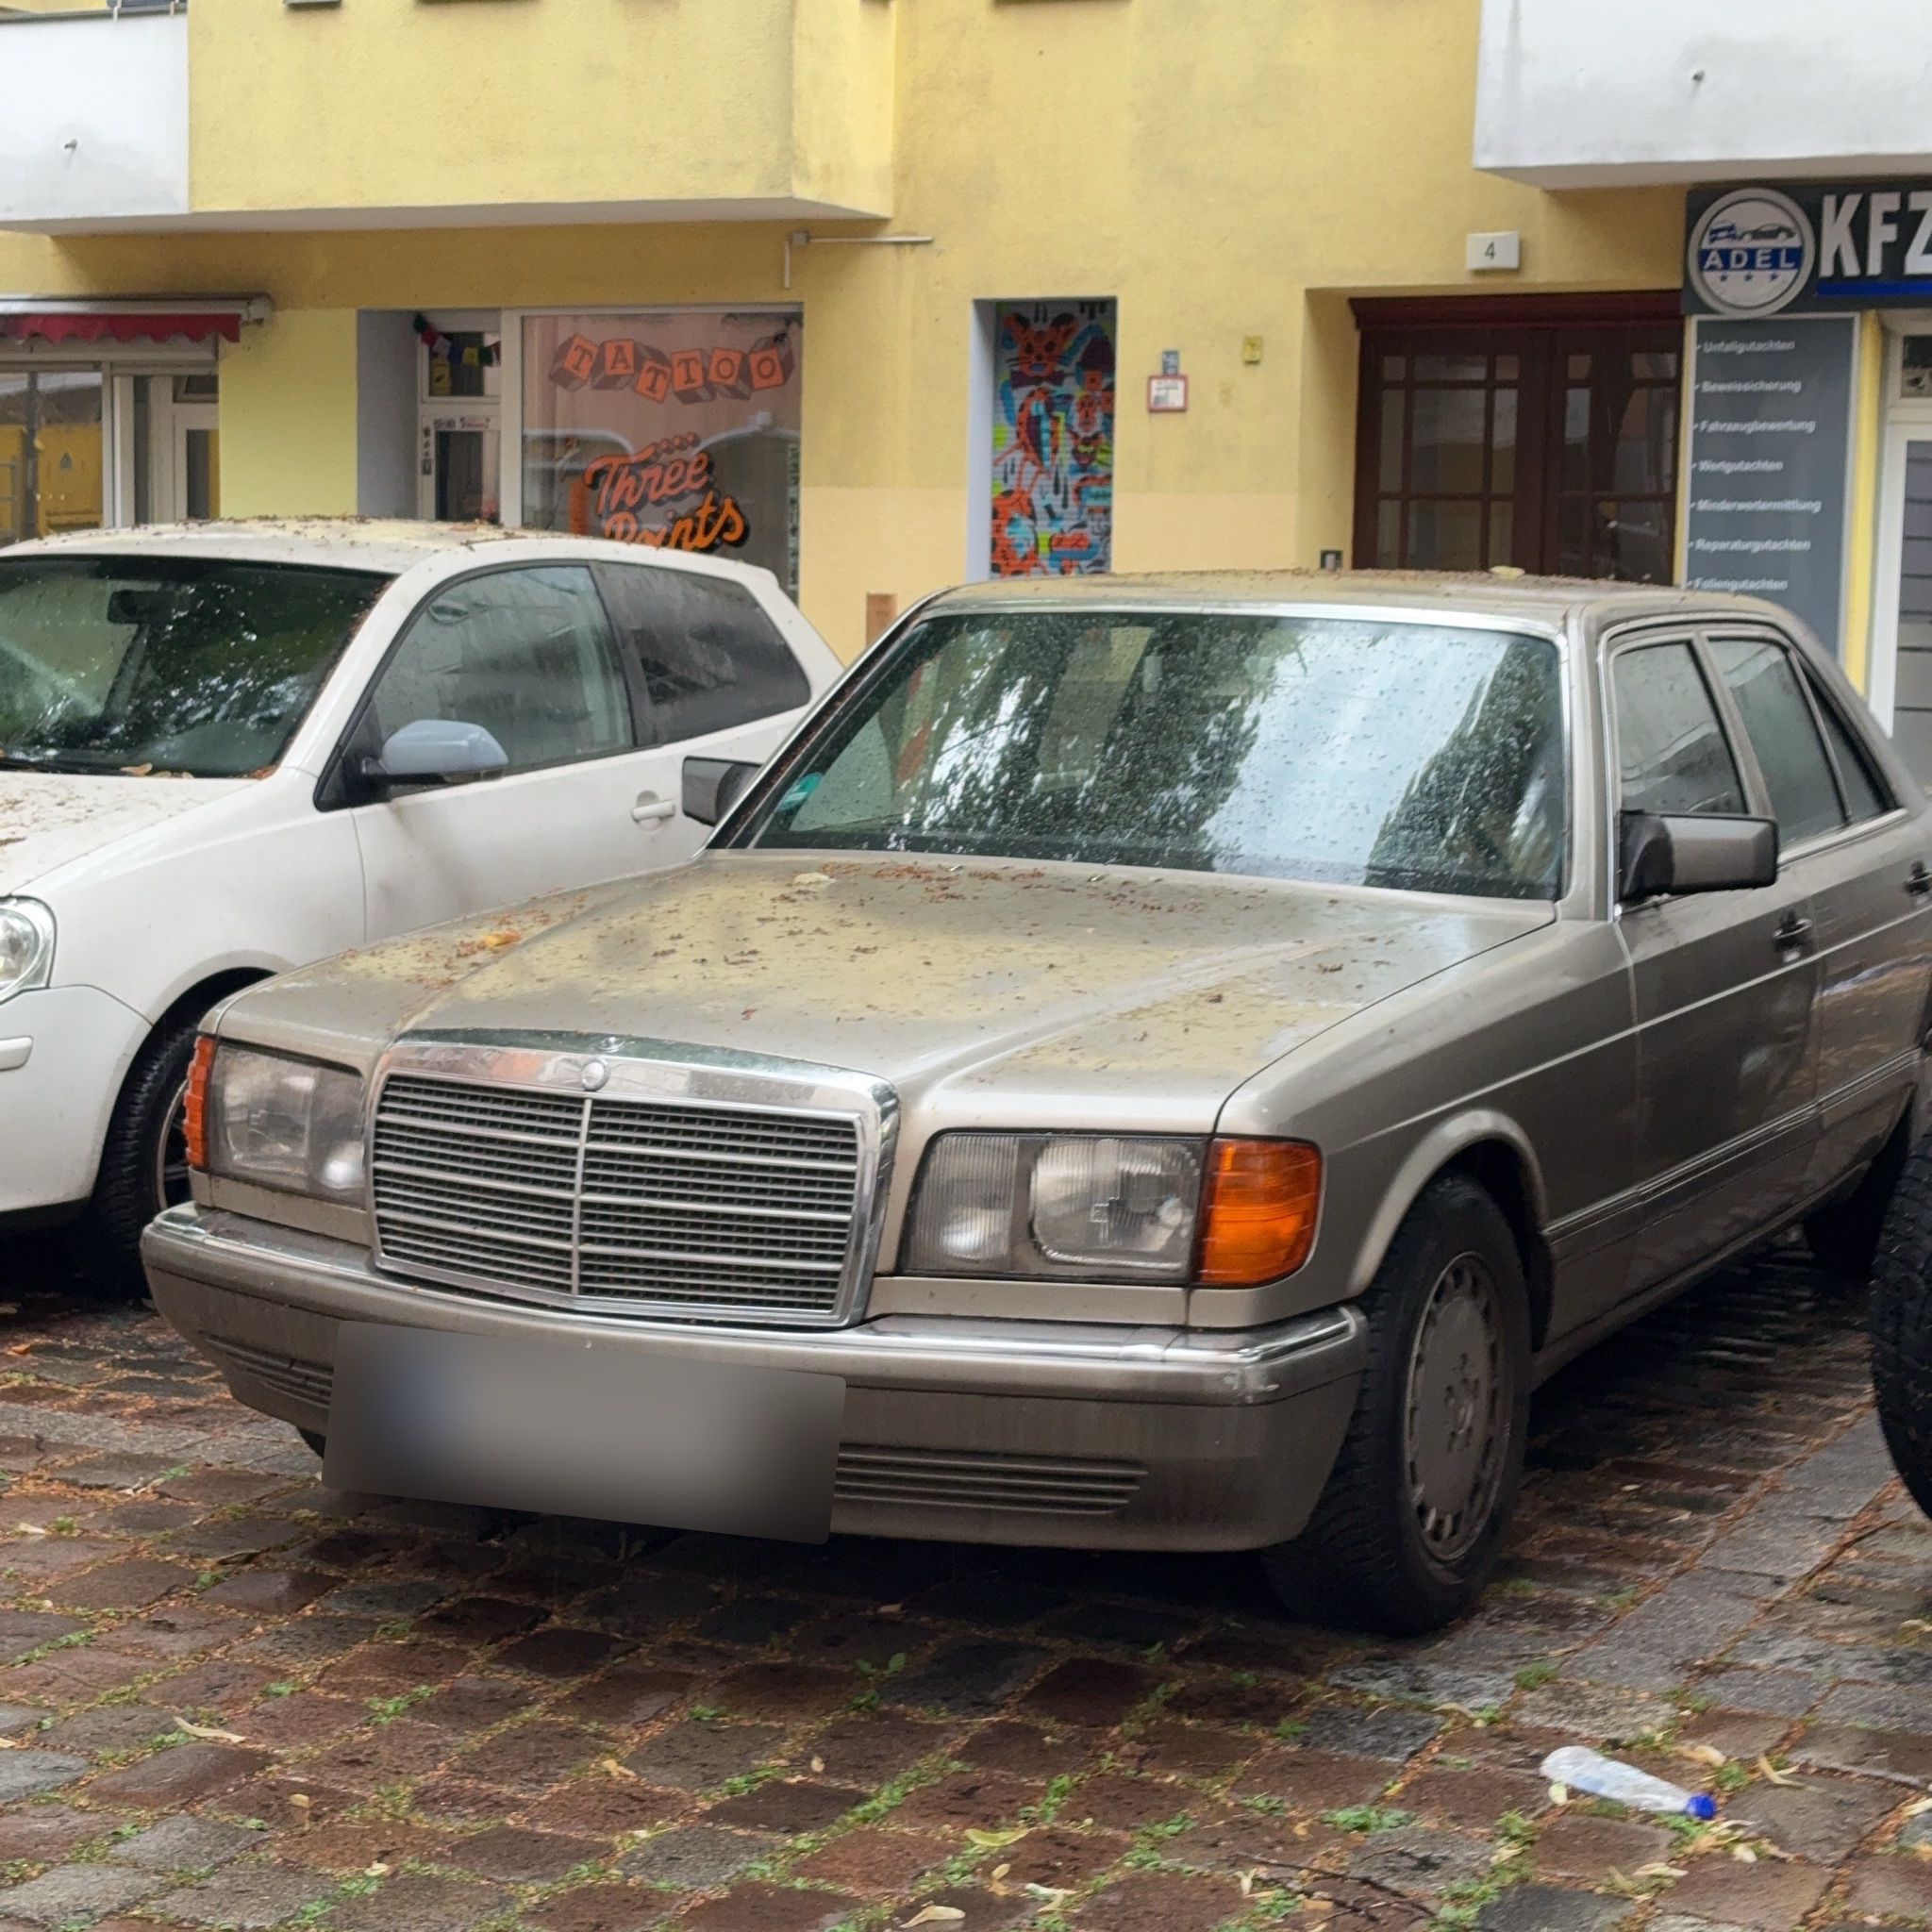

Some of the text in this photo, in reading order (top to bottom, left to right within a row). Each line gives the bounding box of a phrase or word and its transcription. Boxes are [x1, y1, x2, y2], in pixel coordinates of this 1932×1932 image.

[1818, 192, 1932, 277] KFZ
[1484, 241, 1496, 260] 4
[1703, 248, 1796, 270] ADEL
[571, 343, 777, 395] TATTOO
[1701, 379, 1803, 394] Beweissicherung
[1698, 419, 1817, 435] Fahrzeugbewertung
[1698, 459, 1784, 475] Wertgutachten
[582, 441, 709, 517] Three
